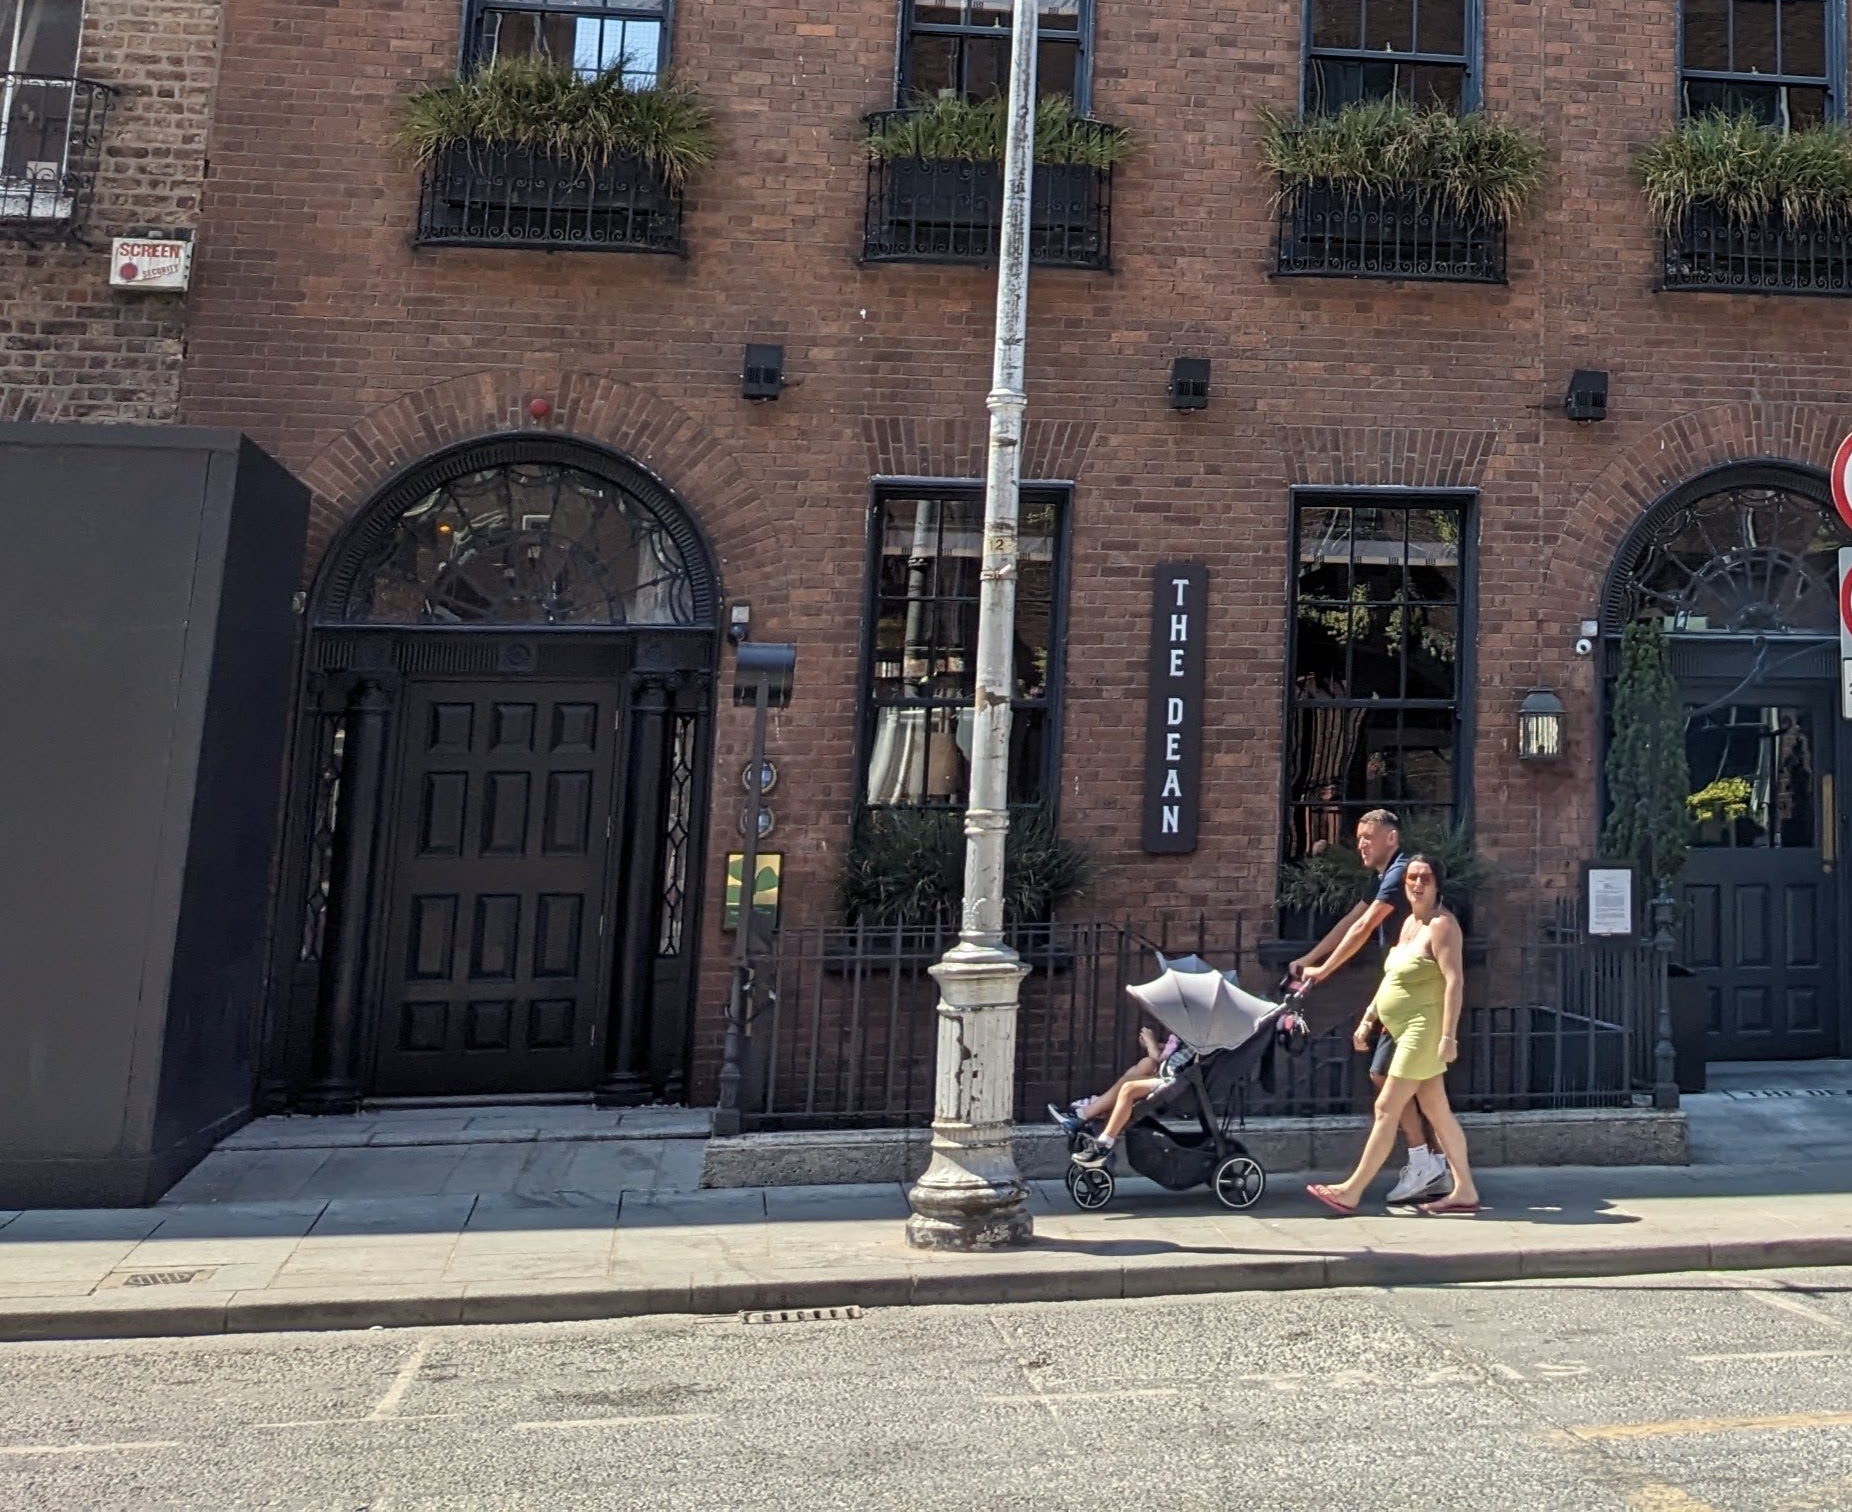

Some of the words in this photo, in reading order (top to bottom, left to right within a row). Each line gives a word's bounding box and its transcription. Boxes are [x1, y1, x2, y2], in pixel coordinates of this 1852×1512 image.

[120, 242, 181, 258] SCREEN
[142, 264, 178, 279] SECURITY
[1169, 578, 1190, 677] THE
[1161, 697, 1184, 834] DEAN
